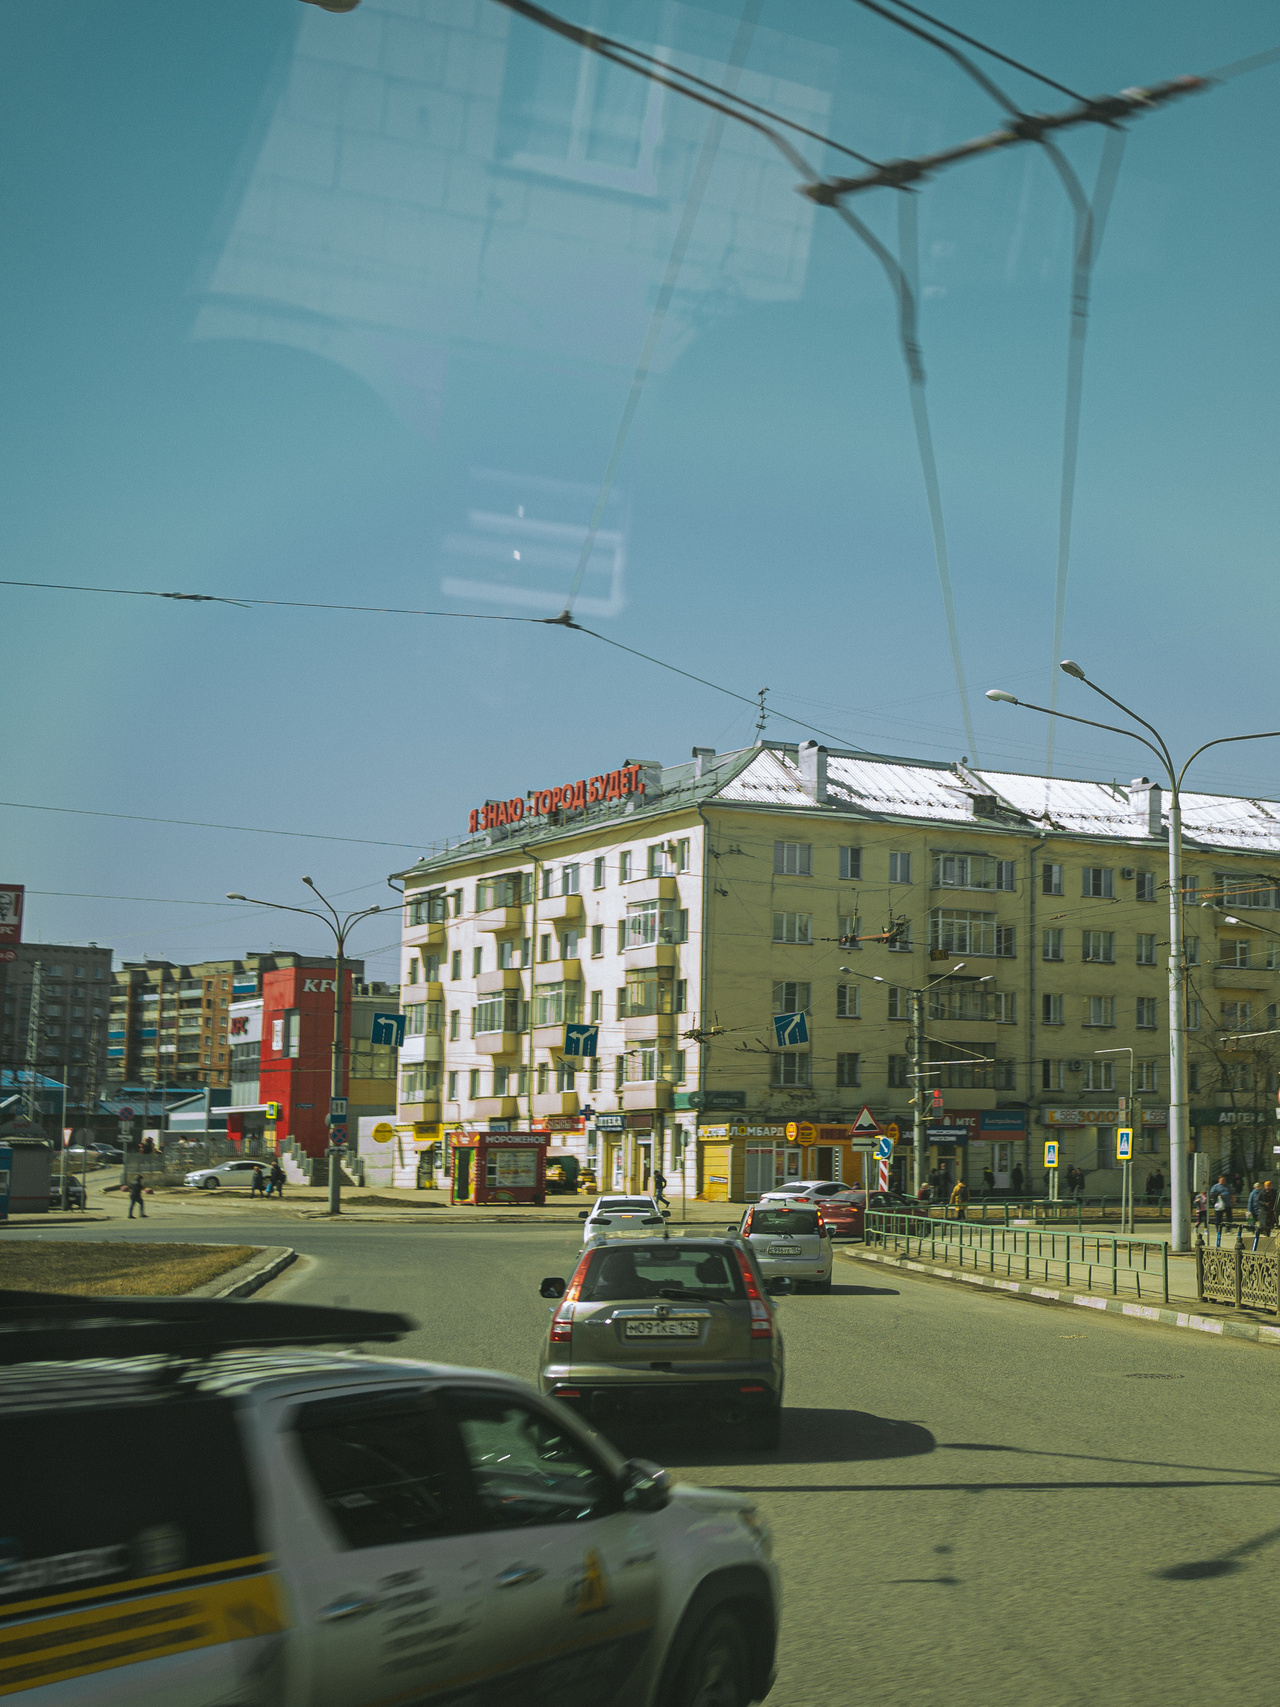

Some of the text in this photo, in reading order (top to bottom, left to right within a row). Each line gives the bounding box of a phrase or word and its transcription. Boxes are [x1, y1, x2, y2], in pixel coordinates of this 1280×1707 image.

[468, 809, 478, 833] Я
[480, 797, 524, 830] ЗНАЮ
[533, 780, 586, 816] ГОРОД
[588, 764, 646, 803] БУДЕТ,
[956, 1118, 976, 1126] МТС
[1218, 1112, 1265, 1123] АПТЕА
[729, 1126, 784, 1136] ЛОМБАРД
